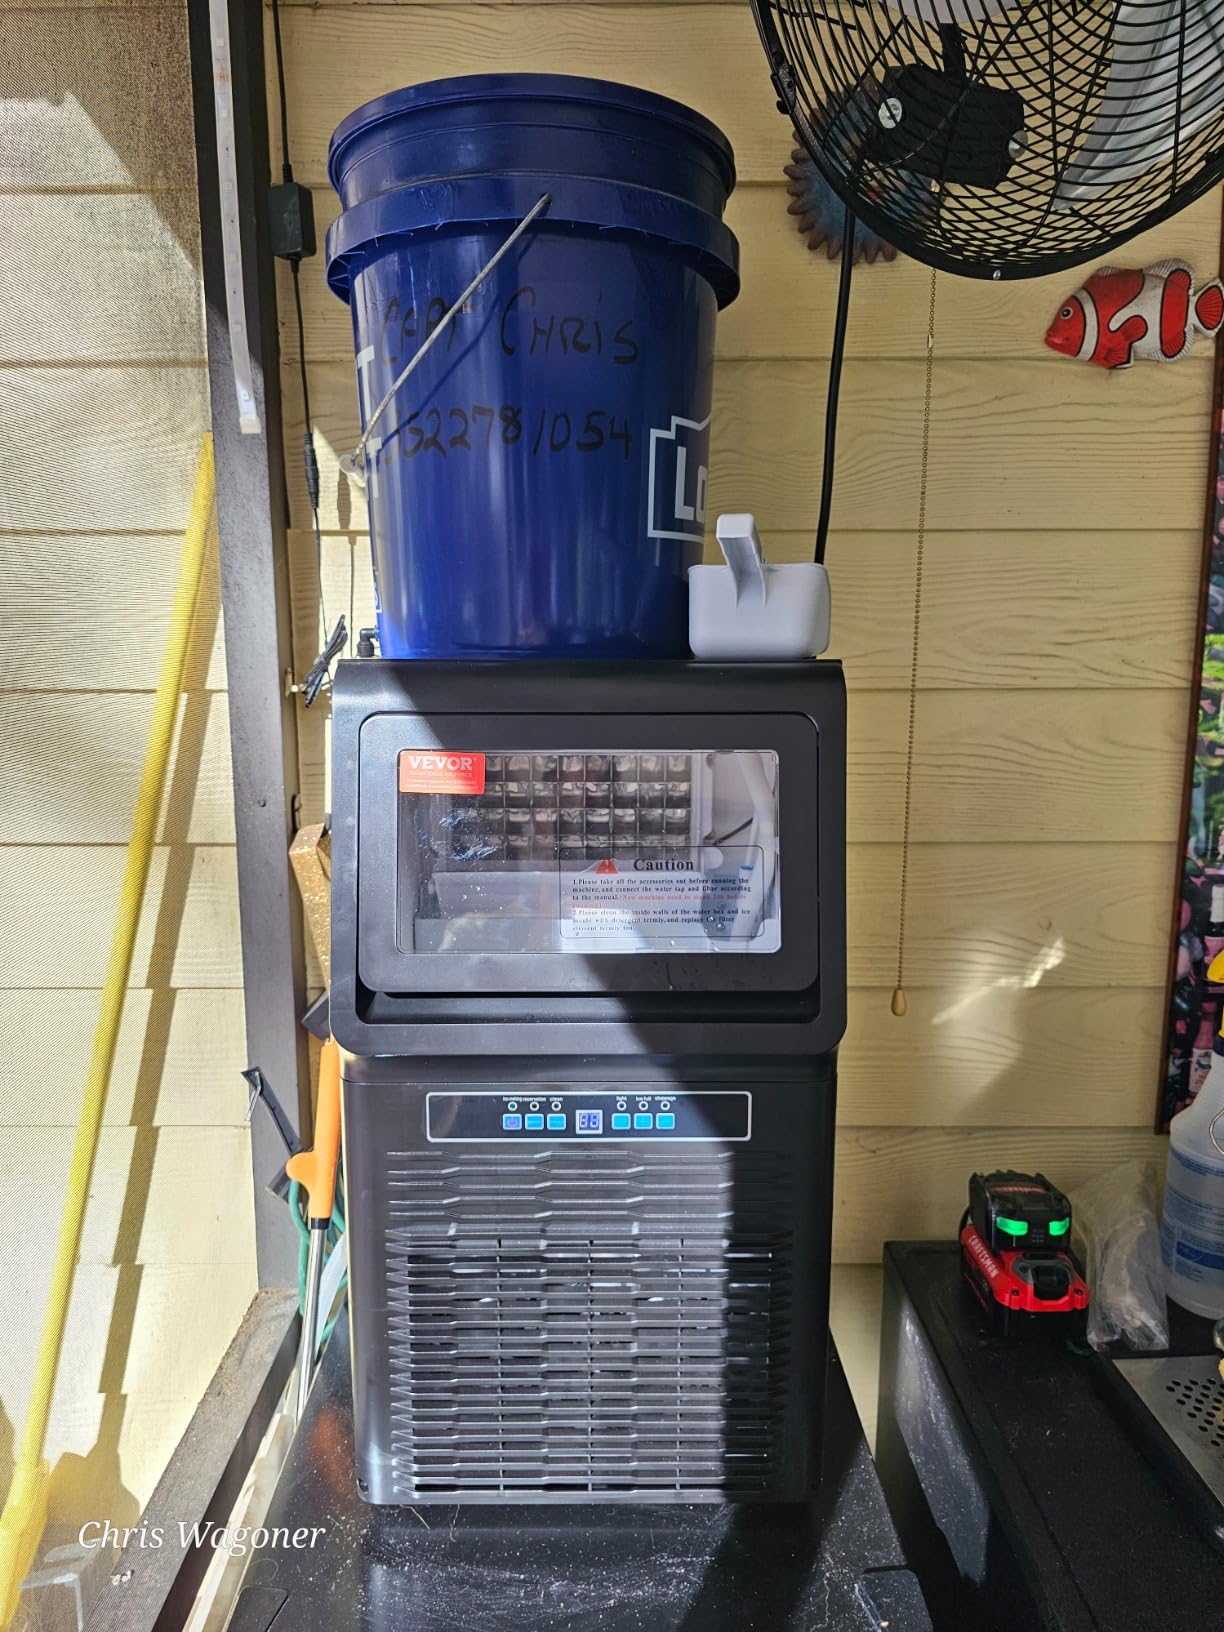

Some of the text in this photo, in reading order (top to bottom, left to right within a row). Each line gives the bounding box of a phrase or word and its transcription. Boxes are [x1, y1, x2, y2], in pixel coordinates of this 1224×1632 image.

[408, 755, 473, 771] VEVOR
[633, 858, 694, 871] Caution
[968, 1235, 1000, 1278] CRAFTSMAN
